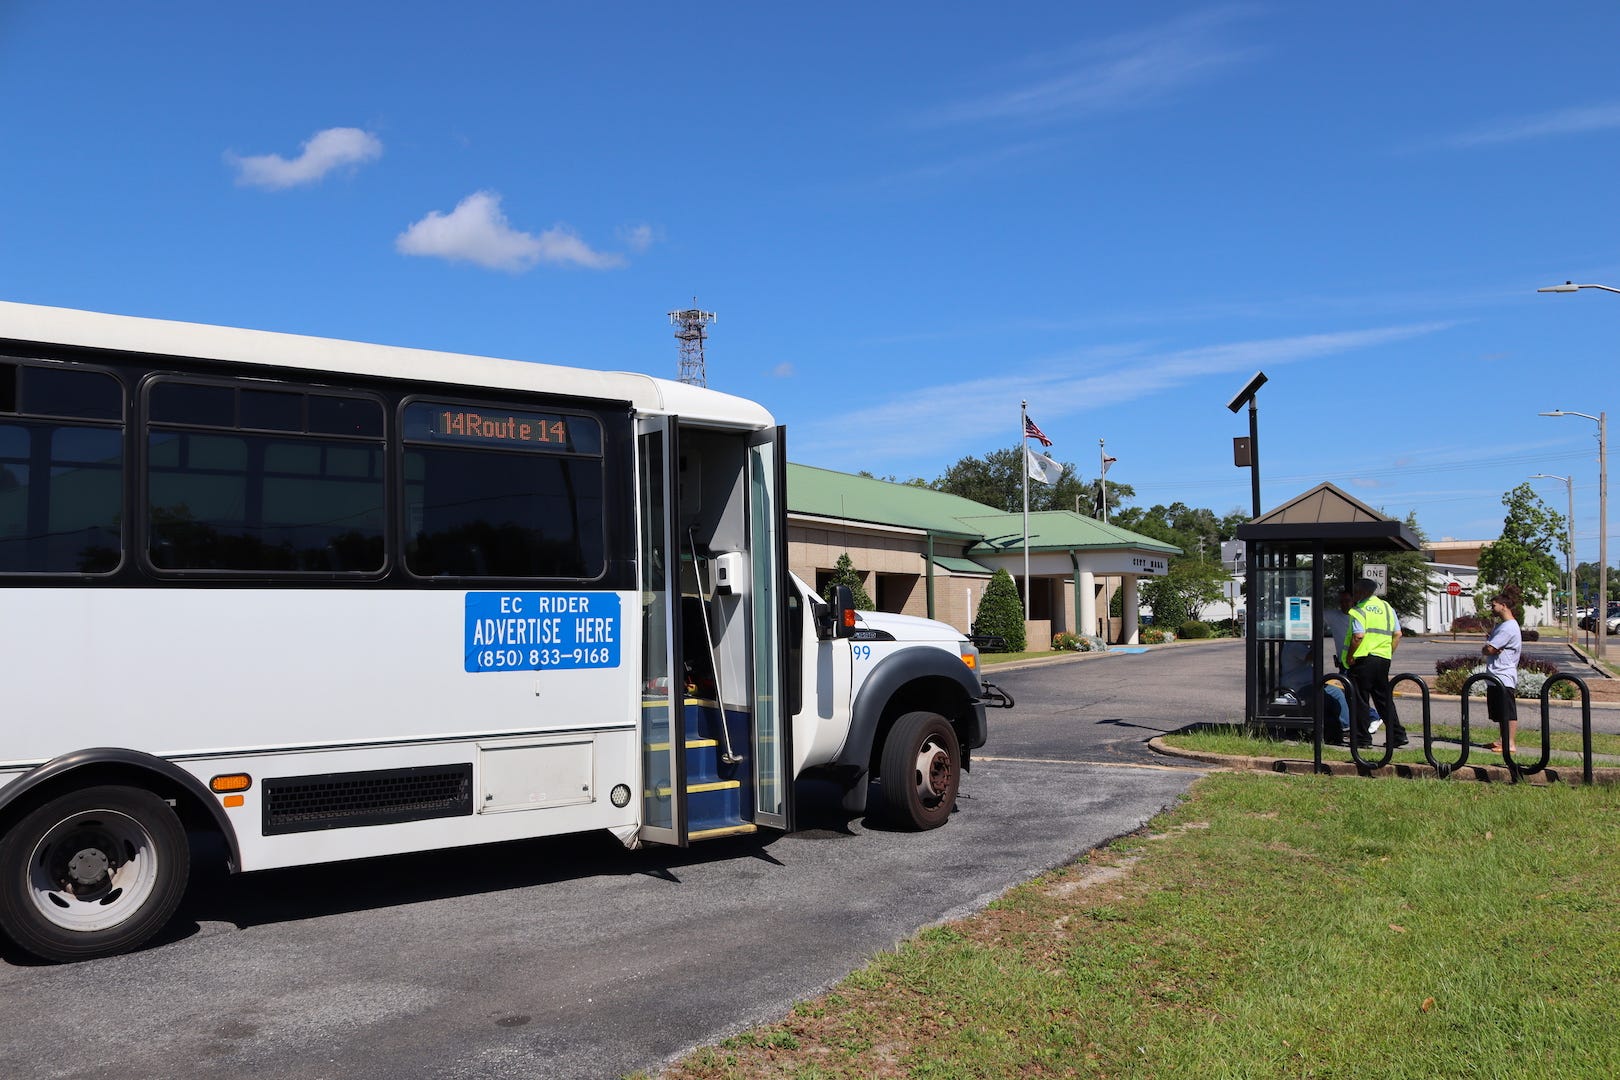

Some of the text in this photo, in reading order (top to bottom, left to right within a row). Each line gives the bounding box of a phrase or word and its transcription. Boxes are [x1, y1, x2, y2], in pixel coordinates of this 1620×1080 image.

[538, 419, 566, 444] 14
[1133, 558, 1163, 569] CITY HALL
[1366, 569, 1384, 578] ONE
[500, 597, 589, 613] EC RIDER
[473, 617, 614, 645] ADVERTISE HERE
[477, 647, 610, 667] (850) 833-9168
[853, 645, 870, 660] 99
